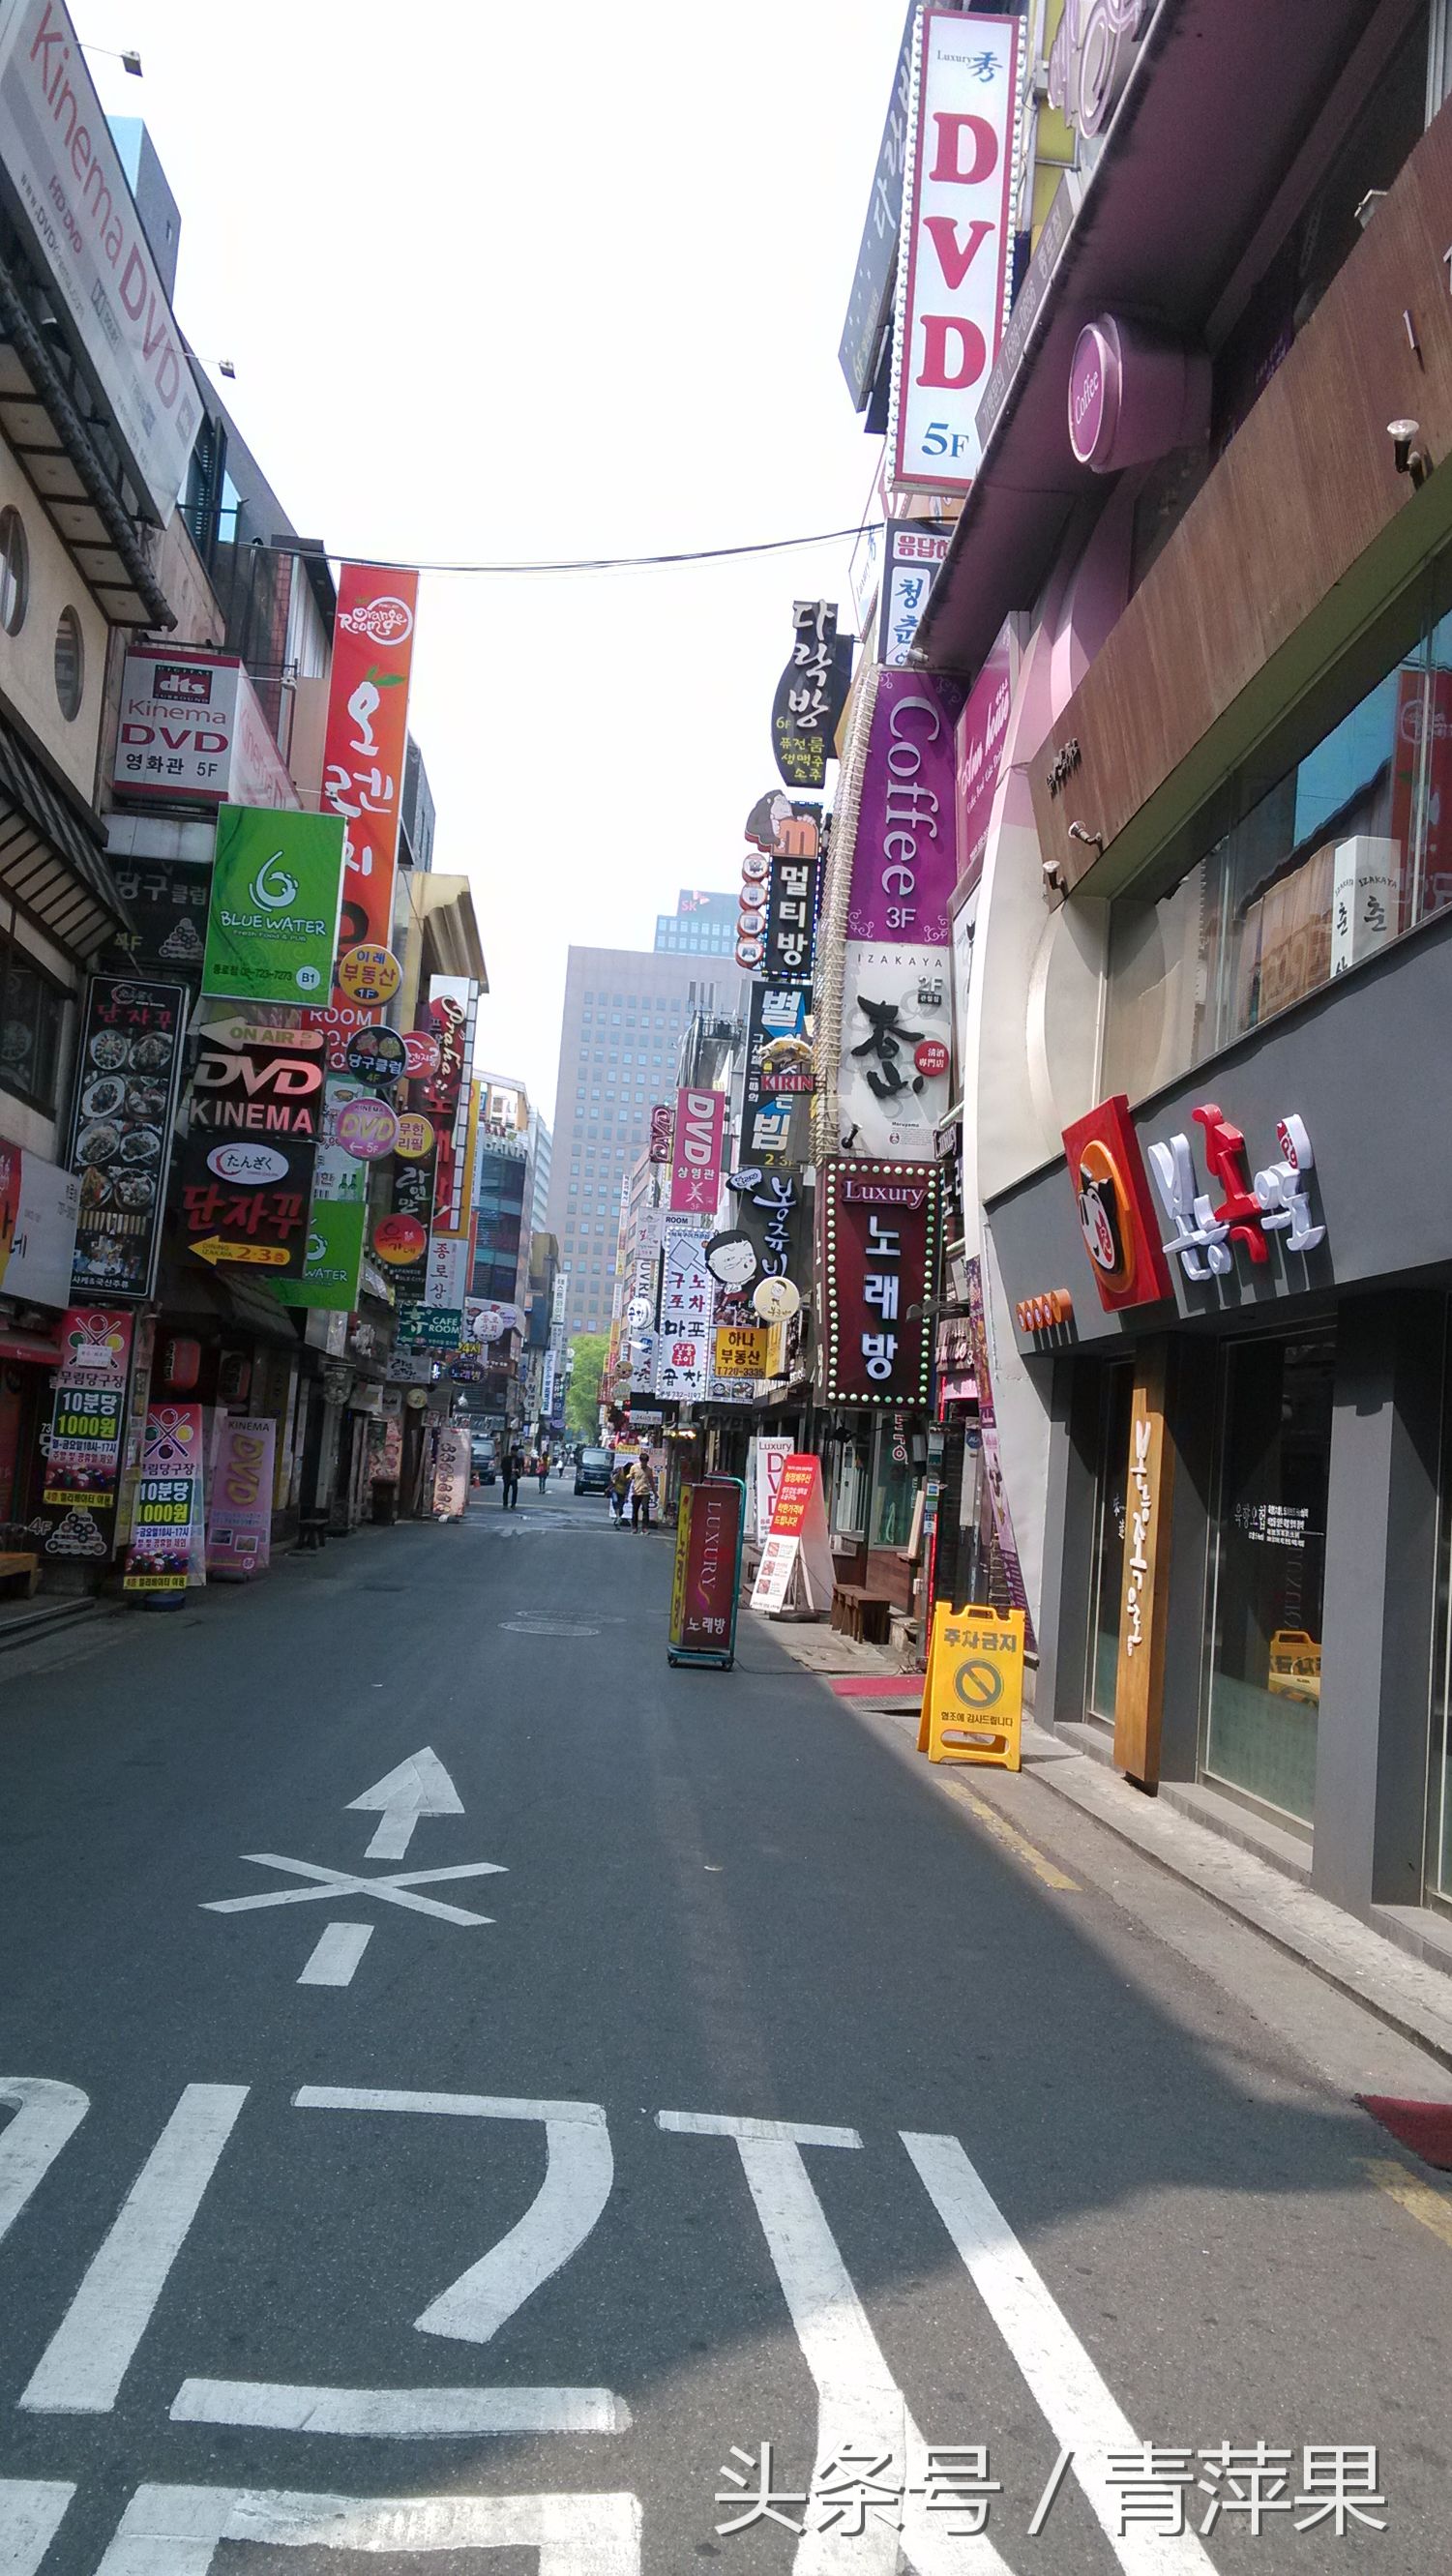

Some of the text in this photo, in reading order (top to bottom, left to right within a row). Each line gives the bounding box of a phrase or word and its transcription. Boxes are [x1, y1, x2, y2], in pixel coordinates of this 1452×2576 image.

[936, 49, 972, 66] Luxury
[29, 5, 181, 409] Kinema DVD
[916, 111, 999, 391] DVD
[1075, 370, 1100, 426] Coffee
[921, 423, 970, 459] 5F
[338, 607, 406, 636] Orange Room
[788, 600, 838, 729] 다락방
[160, 674, 206, 696] dts
[128, 698, 226, 725] Kinema
[776, 716, 792, 730] 6F
[121, 723, 229, 754] DVD
[126, 753, 219, 778] 영화관 5F
[880, 695, 940, 896] Coffee
[221, 910, 327, 936] BLUE WATER
[776, 865, 809, 966] 멀티방
[886, 906, 917, 930] 3F
[356, 951, 386, 964] 이래
[857, 954, 943, 967] IZAKAYA
[301, 971, 316, 985] B1
[343, 962, 397, 988] 부동산
[918, 975, 943, 993] 2F
[358, 988, 376, 999] 1F
[229, 1026, 295, 1045] ON AIR
[193, 1051, 323, 1098] DVD
[366, 1072, 380, 1082] 4F
[760, 1074, 815, 1092] KIRIN
[189, 1097, 313, 1135] KINEMA
[340, 1112, 397, 1141] DVD
[399, 1122, 426, 1137] 무한
[684, 1093, 716, 1167] DVD
[366, 1142, 379, 1153] 5F
[398, 1138, 424, 1152] 리필
[677, 1166, 716, 1181] 상영관
[844, 1178, 927, 1209] Luxury
[665, 1216, 689, 1225] ROOM
[304, 1268, 348, 1283] WATER
[430, 1241, 451, 1307] 종로상
[859, 1215, 903, 1382] 노래방
[428, 1324, 460, 1335] ROOM
[663, 1318, 706, 1339] 마포
[727, 1331, 756, 1348] 하나
[720, 1349, 761, 1368] 부동산
[59, 1370, 126, 1389] 무림당구장
[451, 1369, 481, 1381] 노래방
[662, 1368, 703, 1388] 곱창
[62, 1390, 118, 1416] 10분당
[57, 1414, 116, 1439] 1000원
[228, 1420, 271, 1433] KINEMA
[757, 1441, 793, 1453] Luxury
[225, 1433, 265, 1506] DVD
[140, 1482, 190, 1502] 10분당
[27, 1516, 53, 1536] 4F
[699, 1500, 723, 1589] LUXURY
[687, 1616, 727, 1636] 노래방
[942, 1627, 1019, 1653] 주차금지
[940, 1710, 1015, 1729] 협조에 감사드립니다
